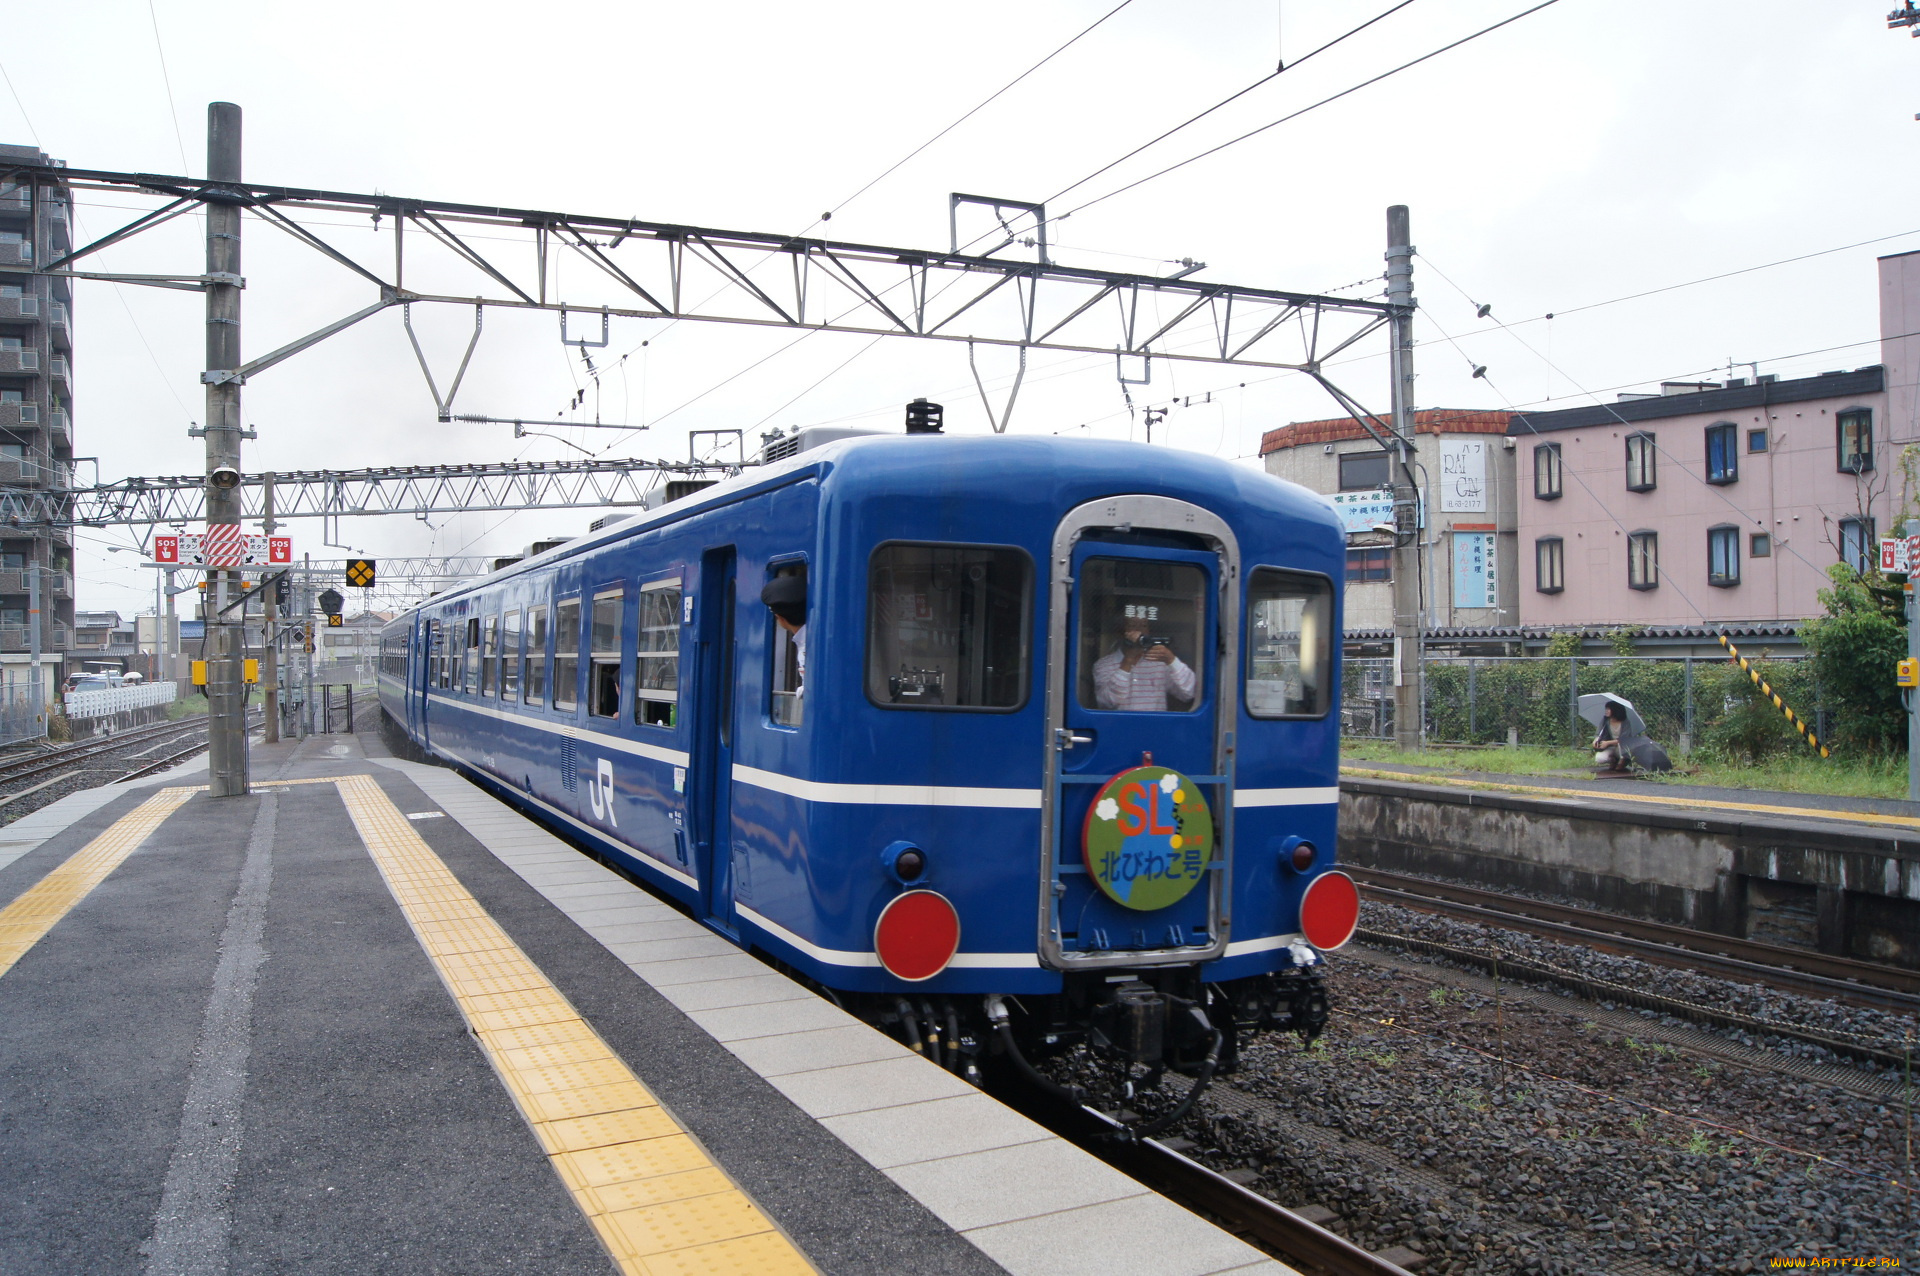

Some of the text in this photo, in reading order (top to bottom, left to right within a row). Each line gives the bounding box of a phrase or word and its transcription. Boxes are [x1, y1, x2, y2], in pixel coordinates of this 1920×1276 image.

[1334, 492, 1394, 503] 喫茶&居酒
[1349, 505, 1391, 515] 沖縄料理
[589, 758, 618, 828] JR
[1117, 782, 1174, 836] SL
[1100, 850, 1203, 883] 北びわこ号
